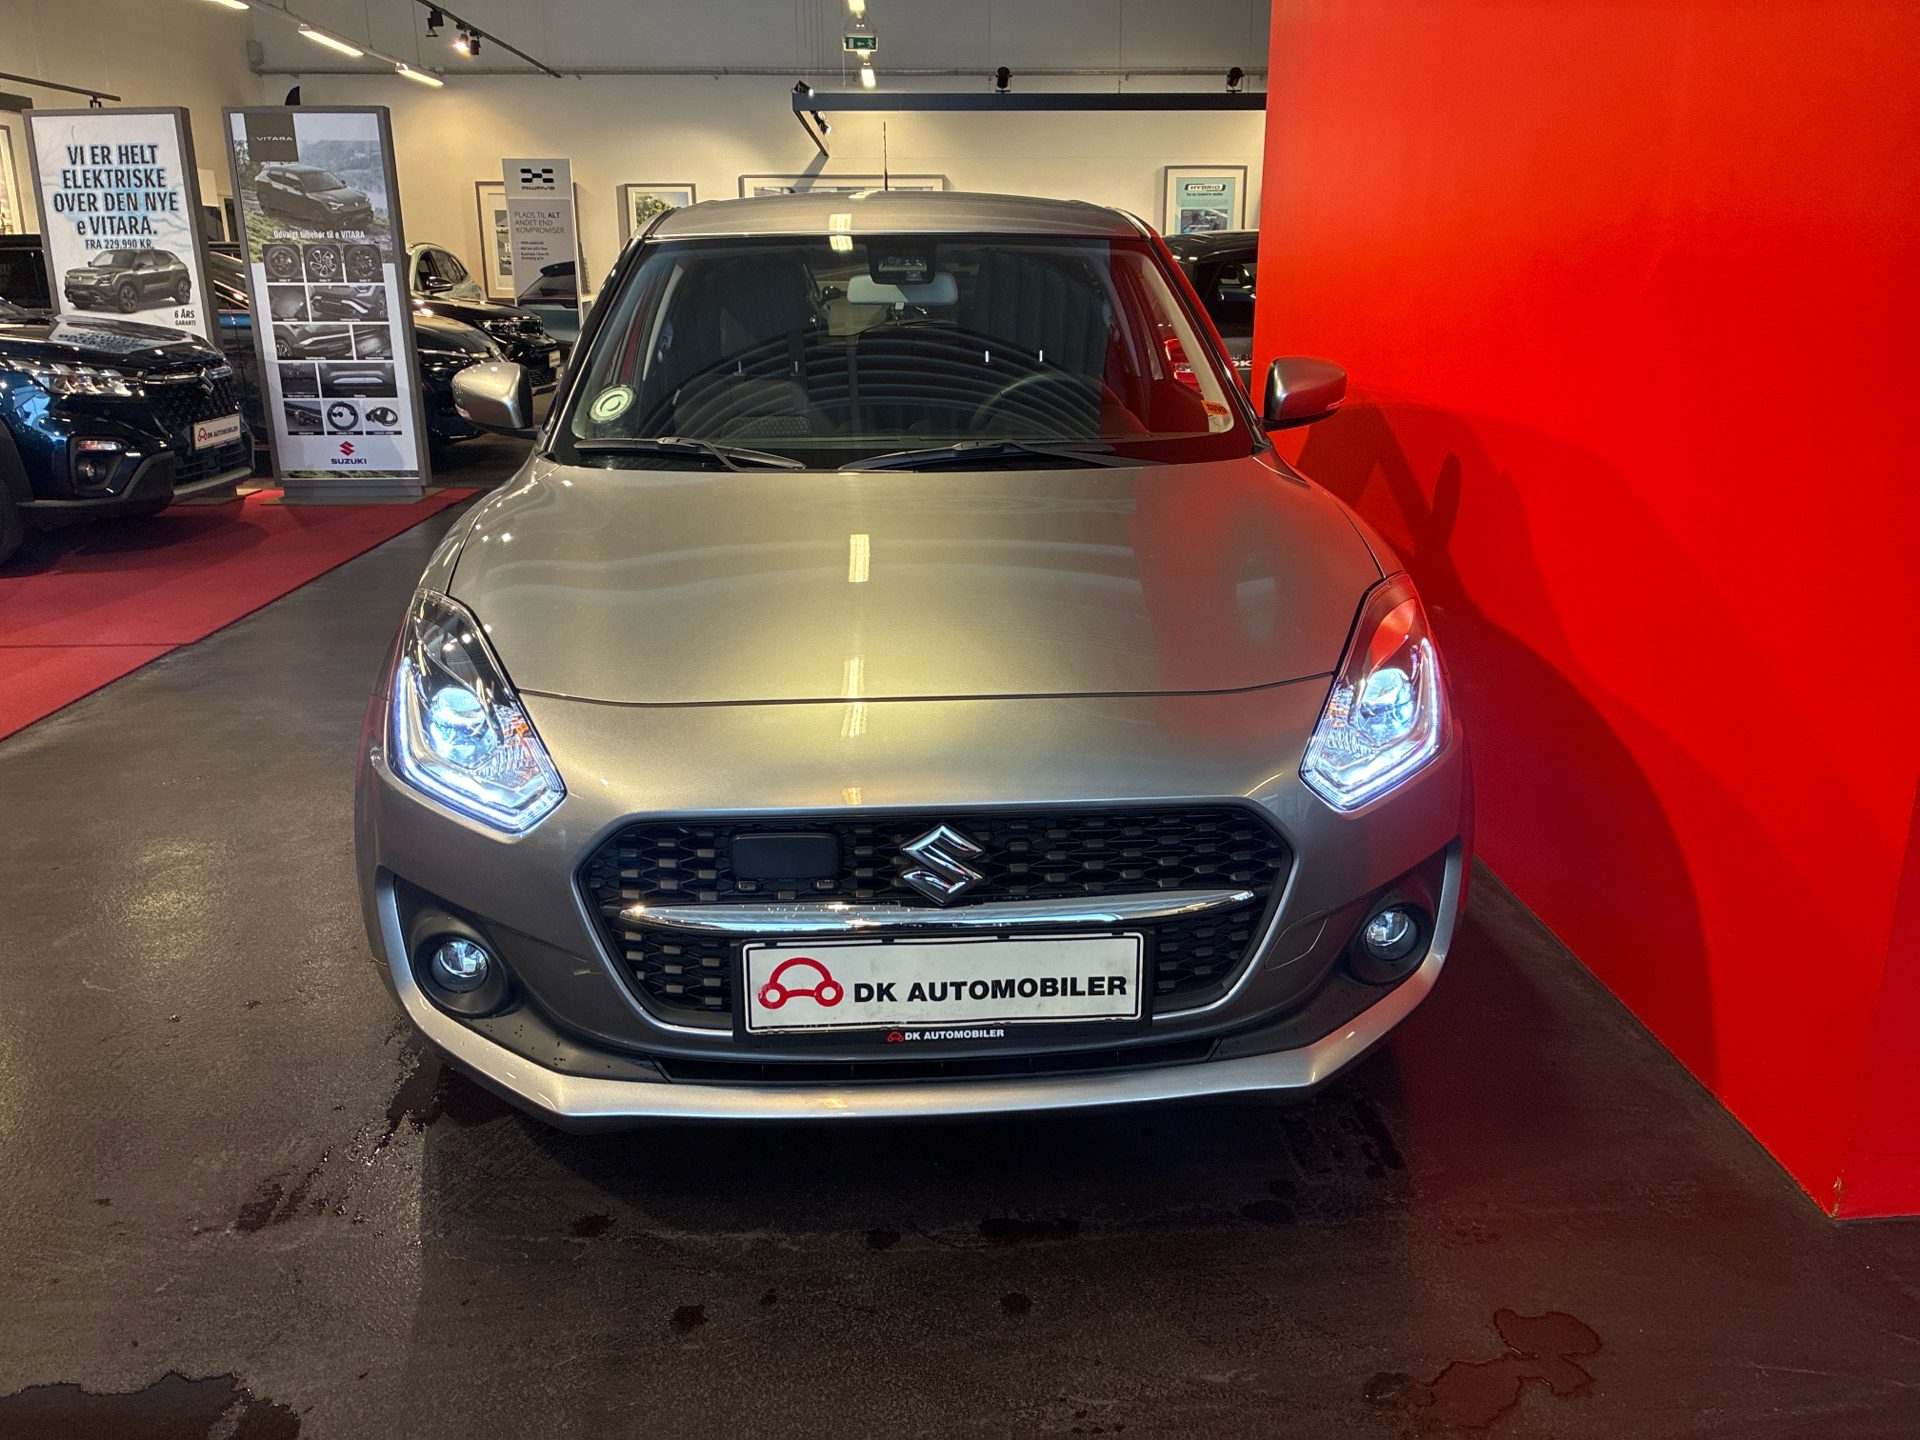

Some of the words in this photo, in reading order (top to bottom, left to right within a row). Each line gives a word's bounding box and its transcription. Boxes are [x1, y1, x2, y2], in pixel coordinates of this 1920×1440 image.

[67, 146, 85, 165] VI
[91, 146, 112, 164] ER
[118, 145, 158, 164] HELT
[62, 168, 166, 189] ELEKTRISKE
[54, 193, 97, 213] OVER
[105, 193, 138, 211] DEN
[145, 192, 178, 211] NYE
[77, 220, 86, 235] e
[89, 216, 158, 235] VITARA.
[341, 230, 365, 238] VITARA
[85, 240, 101, 249] FRA
[105, 239, 137, 250] 229.990
[140, 239, 155, 249] KR.
[175, 310, 179, 319] 6
[181, 308, 195, 319] ÅRS
[214, 426, 238, 437] AUTOMOBILER
[854, 983, 898, 1003] DK
[907, 976, 1127, 1002] AUTOMOBILER
[905, 1033, 920, 1041] DK
[924, 1029, 1005, 1040] AUTOMOBILER
